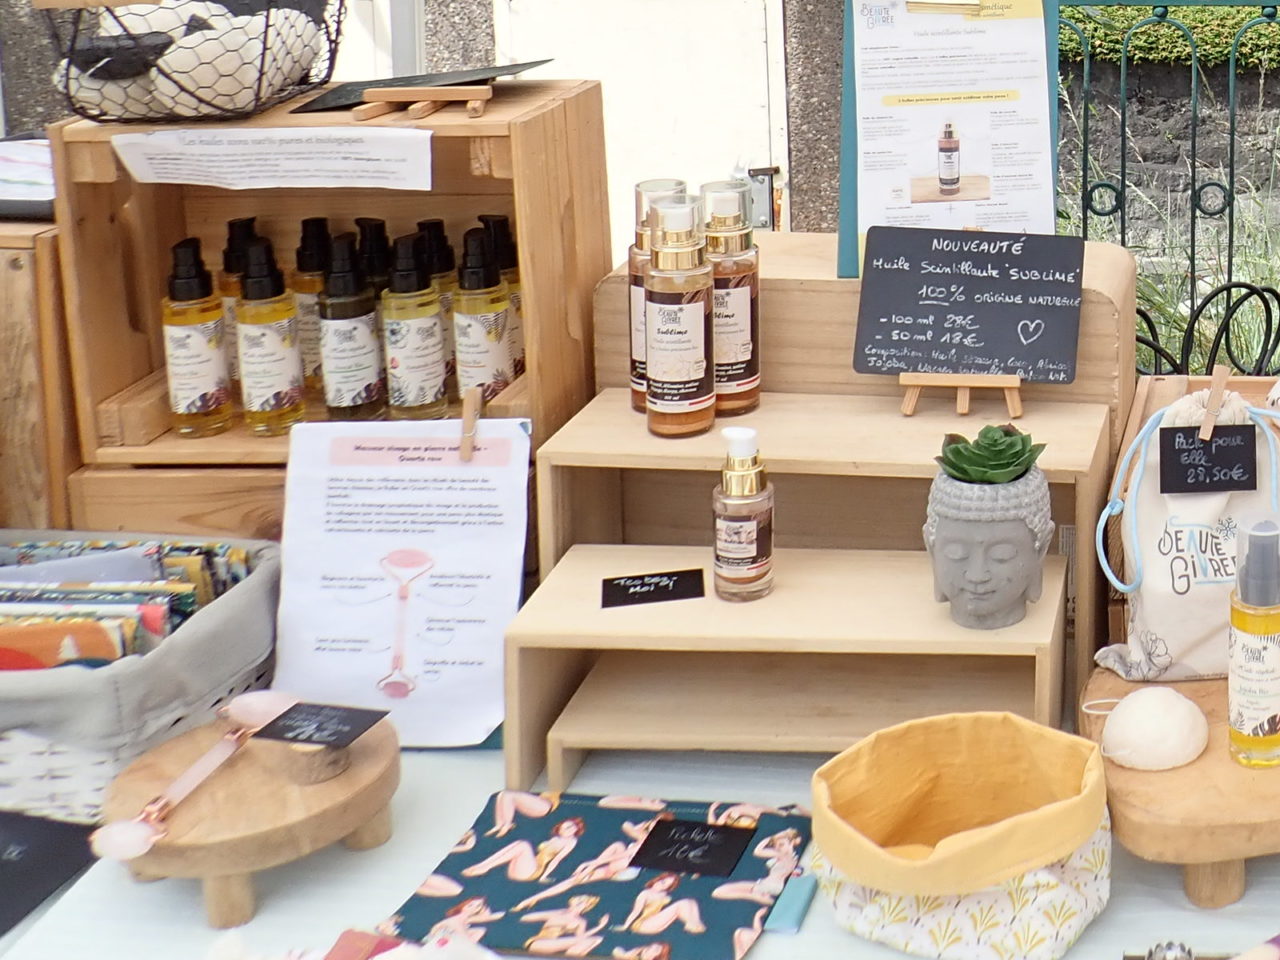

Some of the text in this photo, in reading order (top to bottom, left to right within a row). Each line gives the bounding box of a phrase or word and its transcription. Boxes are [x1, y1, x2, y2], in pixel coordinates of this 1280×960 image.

[932, 236, 1026, 255] NOUVEAUTÉ
[873, 257, 910, 271] Huile
[892, 314, 914, 324] 100
[916, 314, 935, 325] ml
[891, 330, 910, 341] 50
[912, 330, 933, 342] ml
[1180, 450, 1211, 467] Elle
